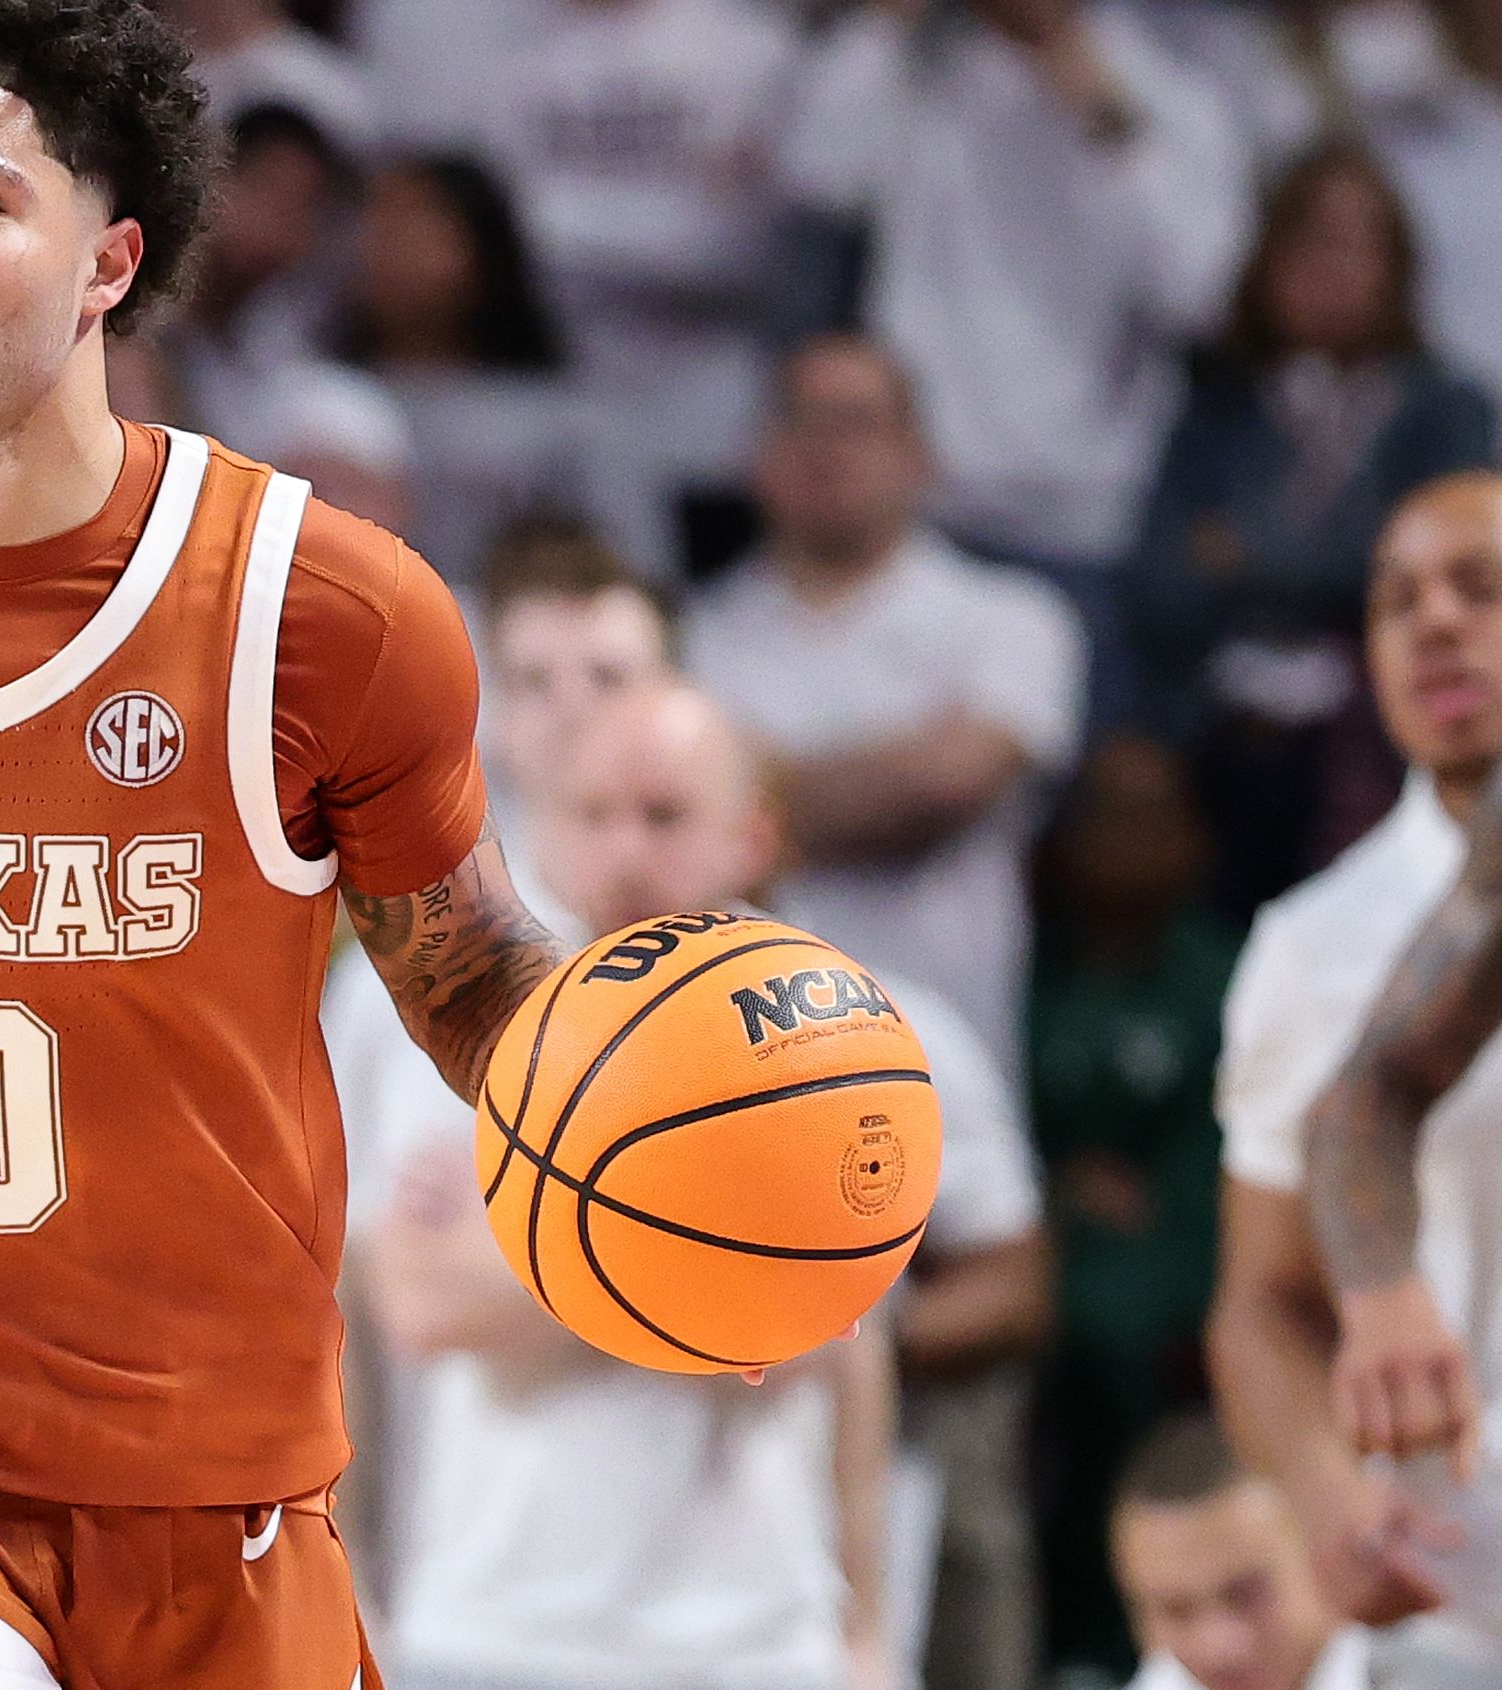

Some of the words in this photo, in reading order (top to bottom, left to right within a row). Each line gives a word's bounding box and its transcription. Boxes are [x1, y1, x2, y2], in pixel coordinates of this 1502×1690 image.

[95, 697, 177, 780] SEC
[730, 968, 902, 1046] NCAA
[755, 1029, 835, 1061] OFFICIAL
